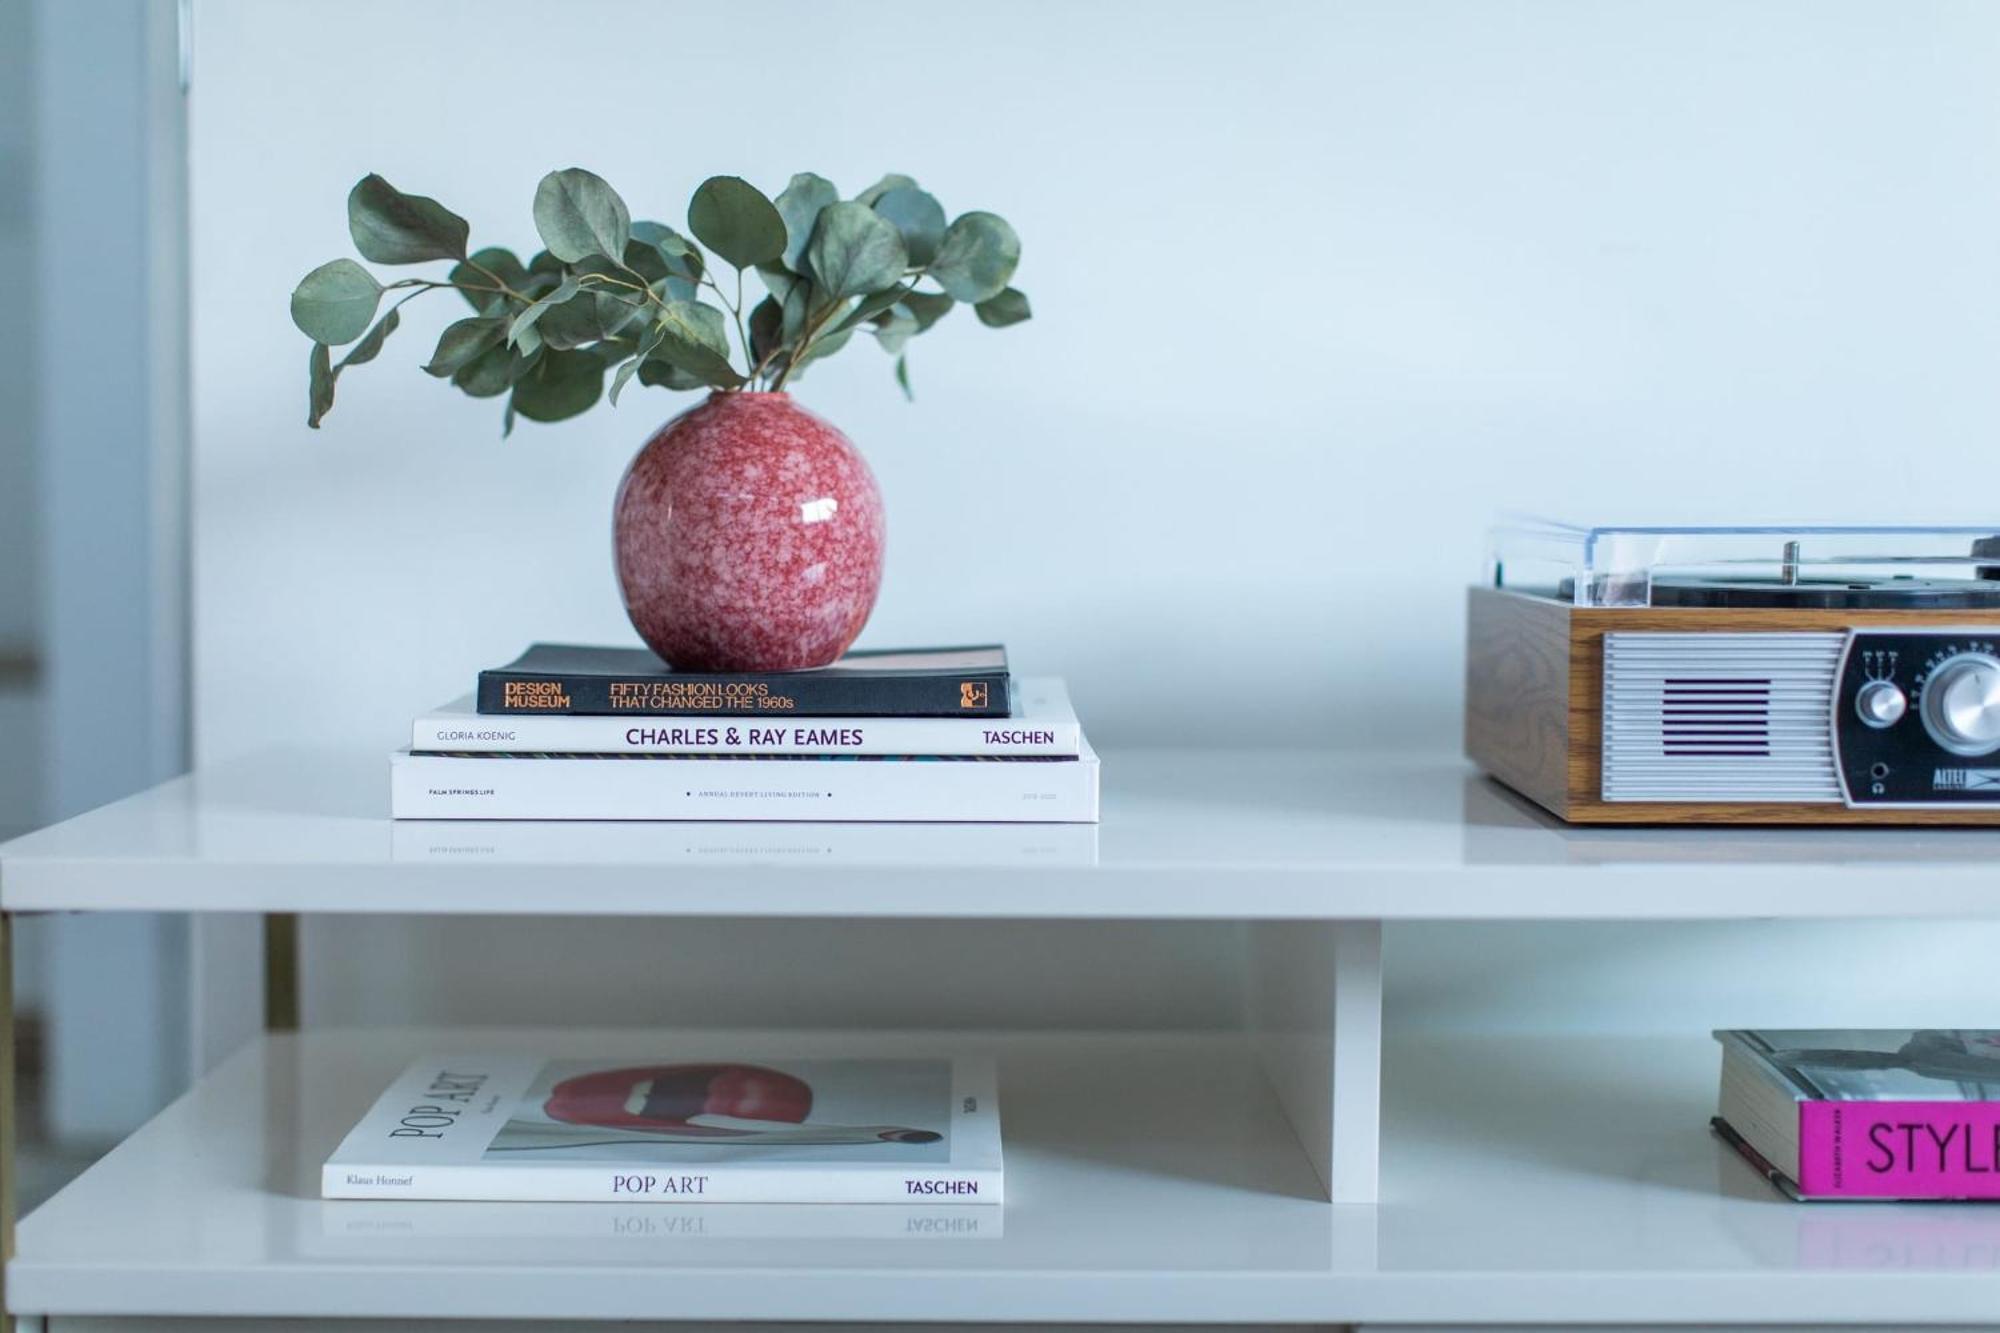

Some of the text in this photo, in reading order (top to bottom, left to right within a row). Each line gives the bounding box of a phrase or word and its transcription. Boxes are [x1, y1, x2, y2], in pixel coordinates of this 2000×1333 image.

[505, 682, 562, 695] DESIGN
[610, 683, 768, 696] FIFTY FASHION LOOKS
[505, 695, 571, 708] MUSEUM
[609, 696, 795, 709] THAT CHANGED THE 1960s
[436, 731, 516, 741] GLORIA KOENIG
[626, 727, 863, 746] CHARLES & RAY EAMES
[982, 730, 1055, 744] TASCHEN
[388, 1069, 488, 1139] POP ART
[346, 1174, 374, 1185] Klaus
[613, 1175, 709, 1194] POP ART
[904, 1180, 979, 1195] TASCHEN
